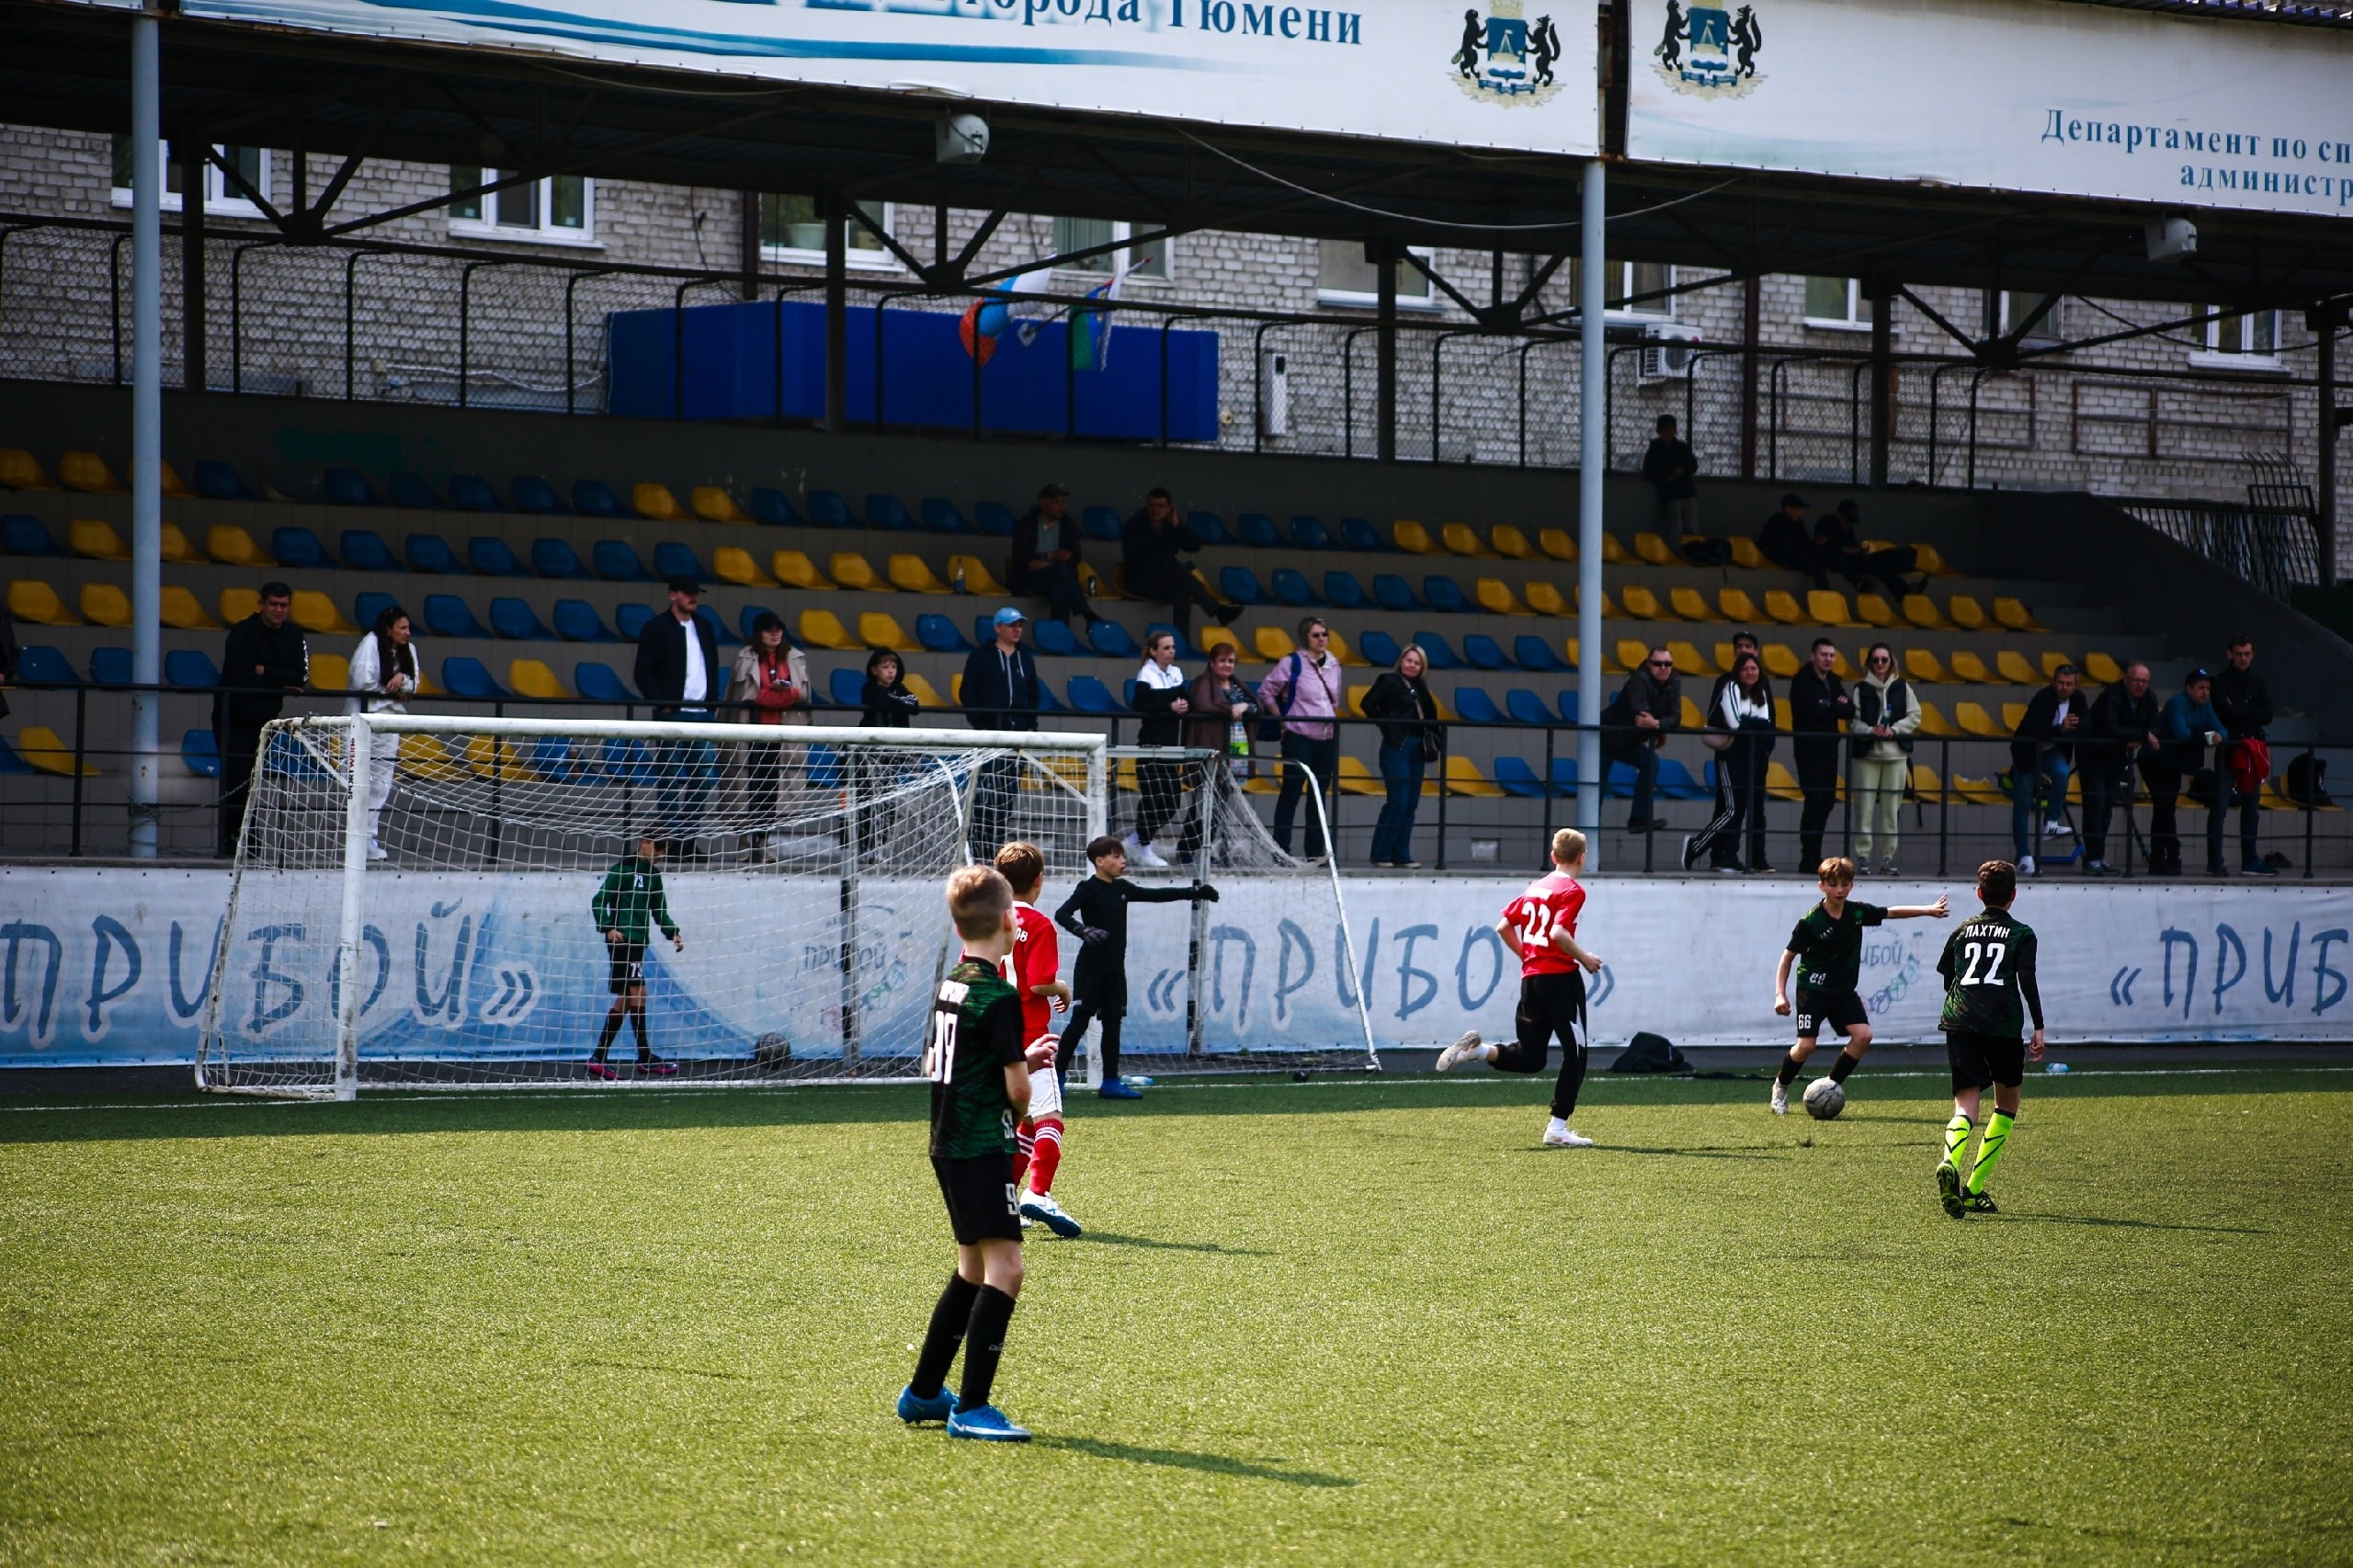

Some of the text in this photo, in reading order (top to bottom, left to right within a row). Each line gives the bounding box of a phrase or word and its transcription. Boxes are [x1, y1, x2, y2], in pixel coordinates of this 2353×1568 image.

[2042, 108, 2351, 164] Департамент по сп
[2180, 165, 2353, 206] администр
[1521, 901, 1551, 948] 22
[1146, 916, 1616, 1025] «ПРИБО»
[1960, 942, 2006, 986] 22
[1798, 1014, 1812, 1029] 66
